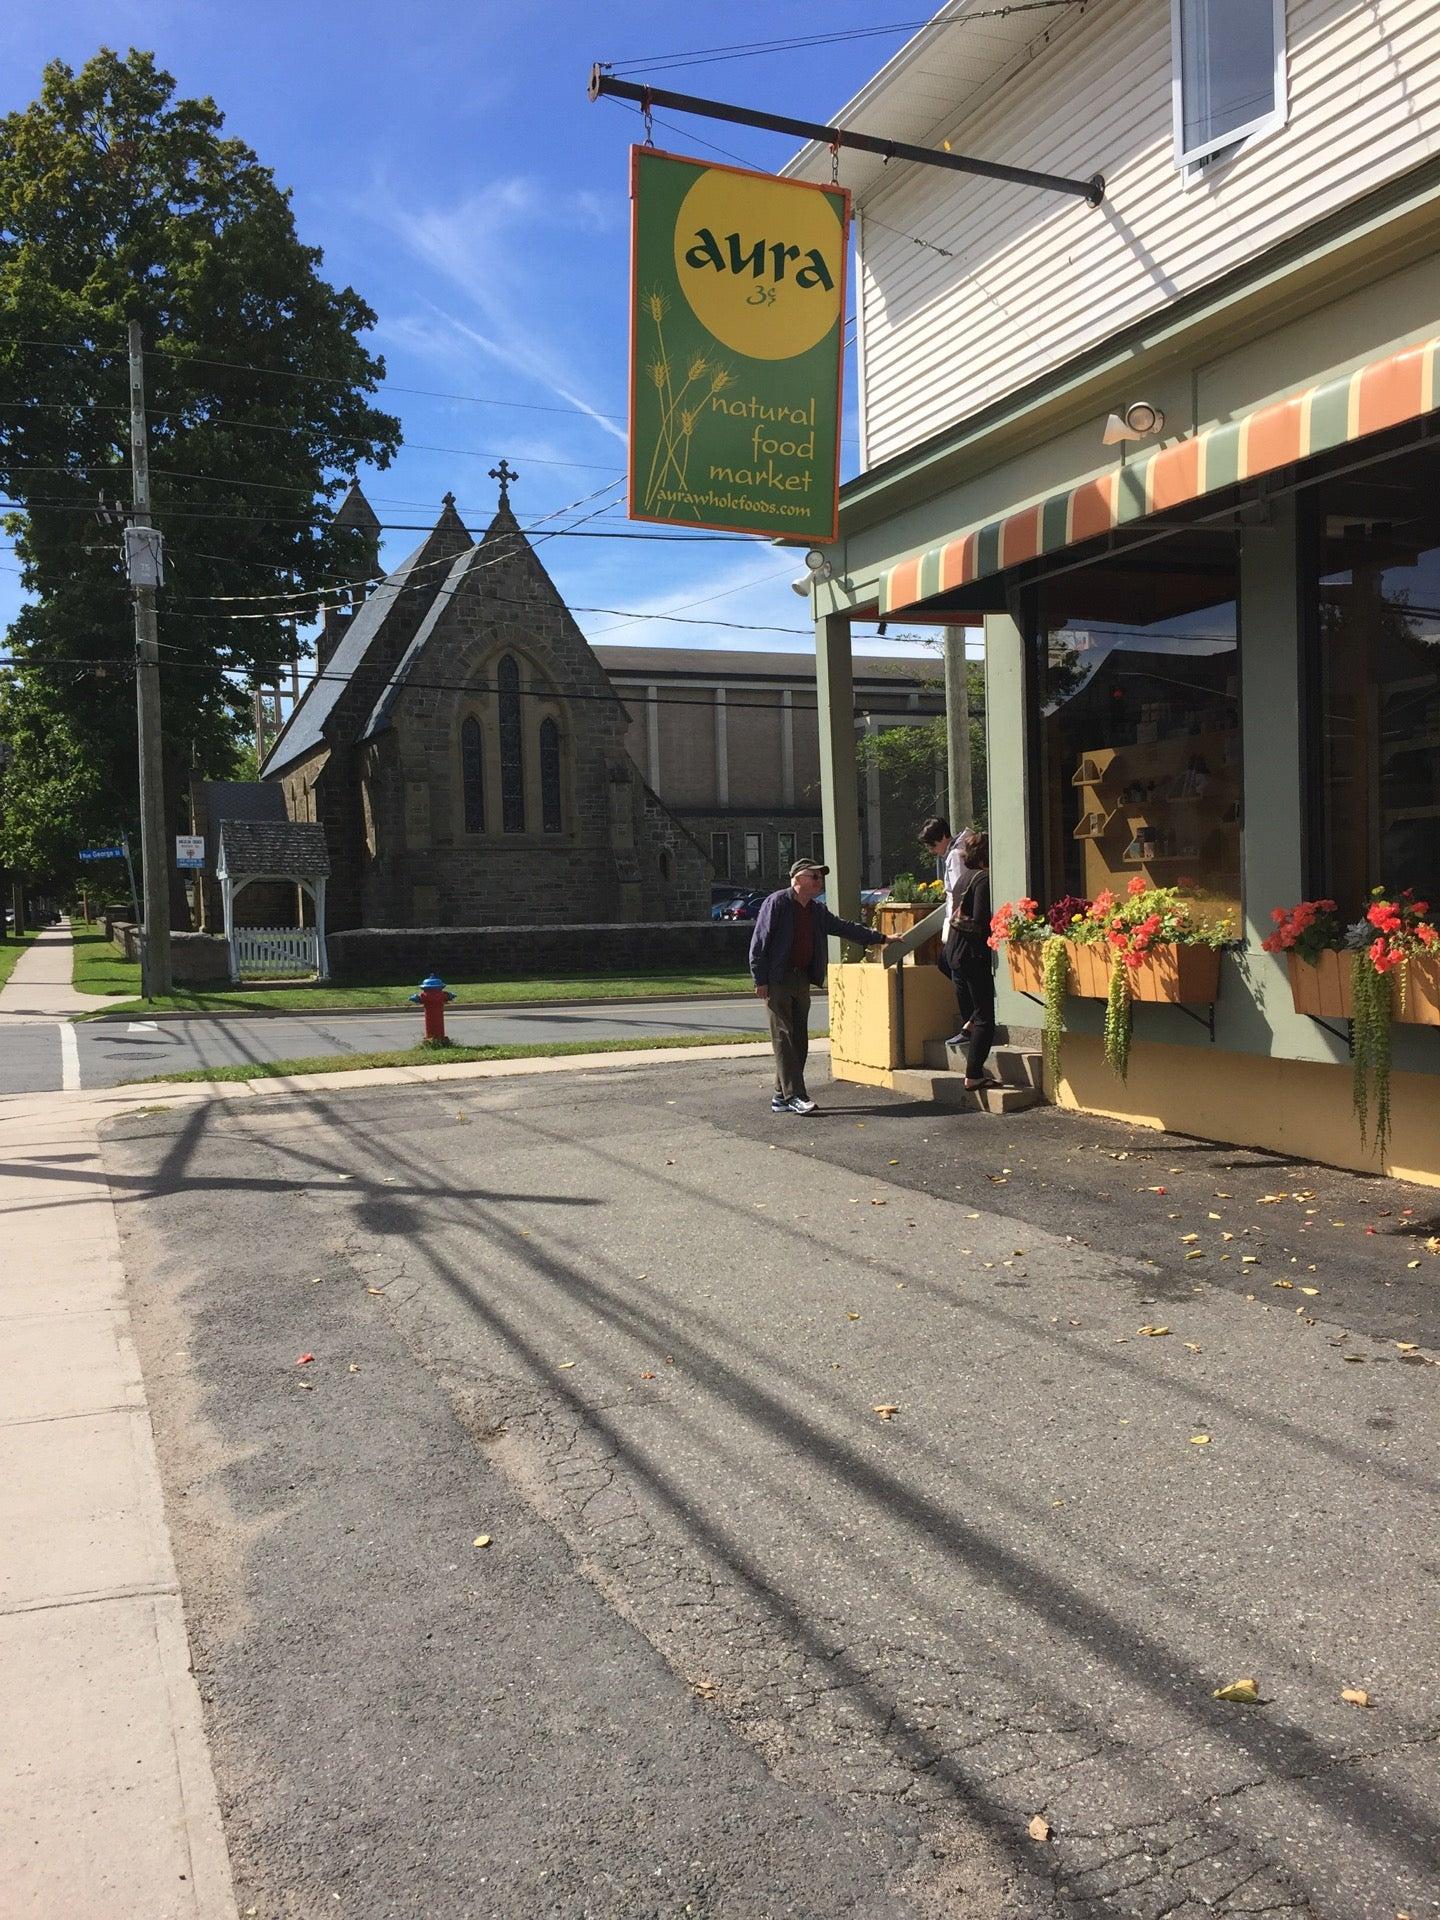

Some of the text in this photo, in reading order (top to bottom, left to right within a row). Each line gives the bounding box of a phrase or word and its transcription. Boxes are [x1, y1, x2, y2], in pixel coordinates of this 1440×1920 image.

[685, 228, 835, 291] aura
[710, 396, 815, 426] natural
[751, 424, 815, 463] food
[709, 461, 812, 493] market
[656, 488, 811, 518] aurawholefoods.com
[92, 850, 113, 858] George
